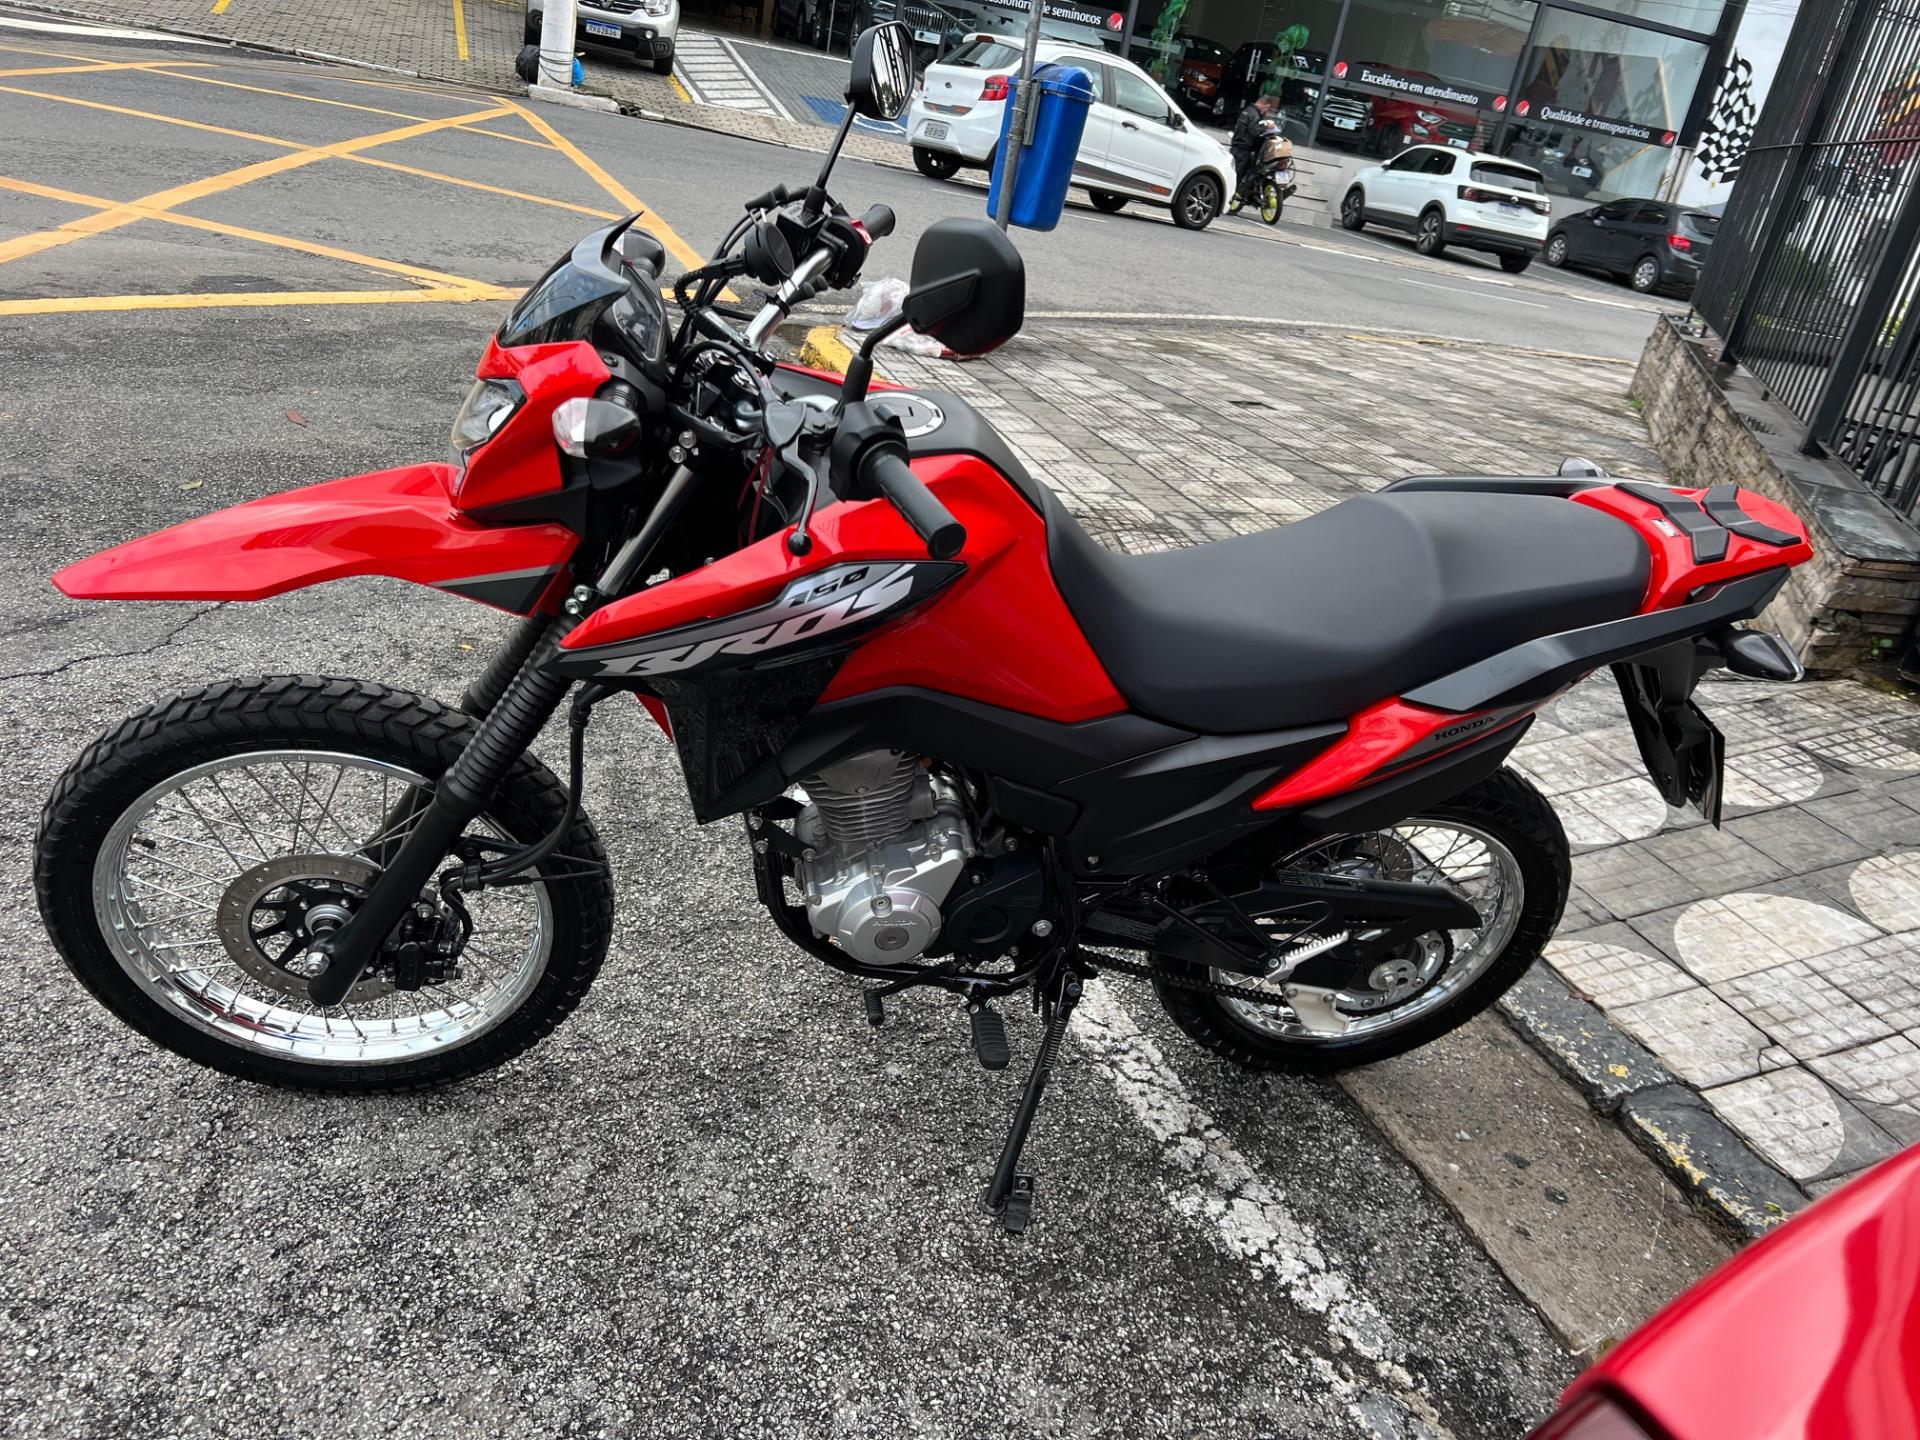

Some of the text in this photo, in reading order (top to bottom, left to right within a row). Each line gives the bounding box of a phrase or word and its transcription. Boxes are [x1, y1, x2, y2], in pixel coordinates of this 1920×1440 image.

[1409, 83, 1424, 94] em
[1424, 85, 1479, 105] atendimento
[1540, 106, 1585, 126] Qualidade
[1585, 117, 1592, 126] e
[594, 563, 917, 677] BROS
[1434, 716, 1496, 741] HONDA
